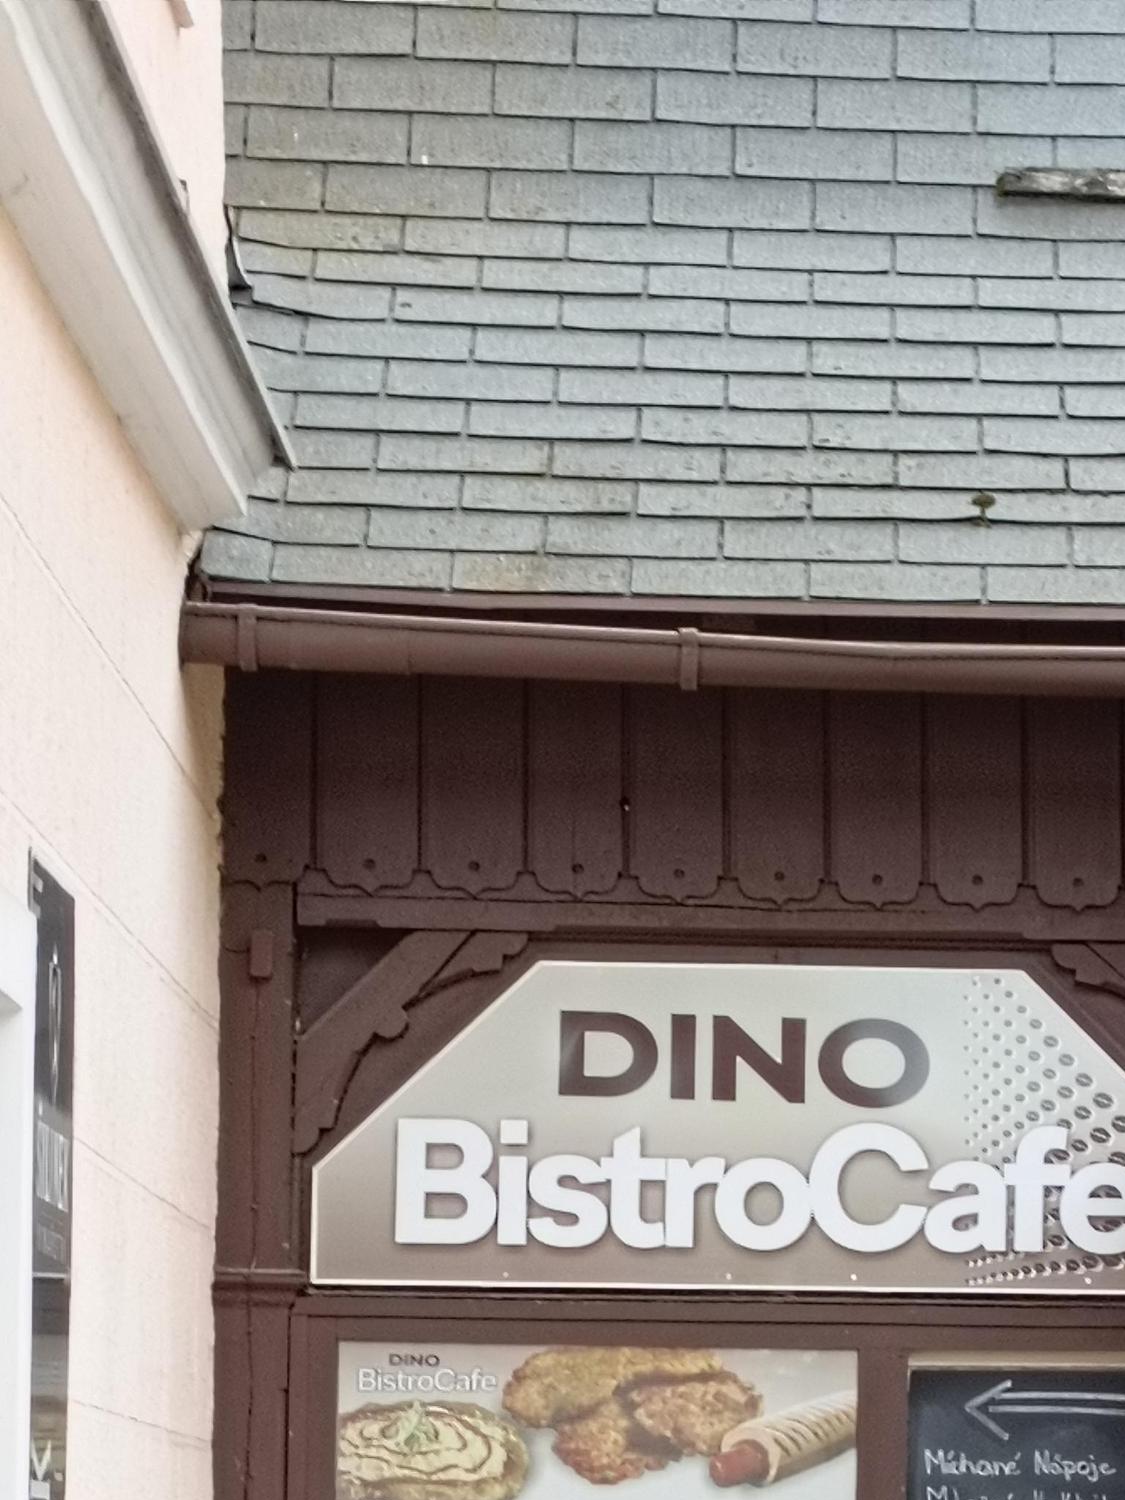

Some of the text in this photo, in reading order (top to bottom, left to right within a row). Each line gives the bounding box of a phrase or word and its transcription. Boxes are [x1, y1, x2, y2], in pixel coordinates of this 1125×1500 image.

[557, 1010, 930, 1107] DINO
[389, 1353, 440, 1367] DINO
[357, 1368, 497, 1392] BistroCafe
